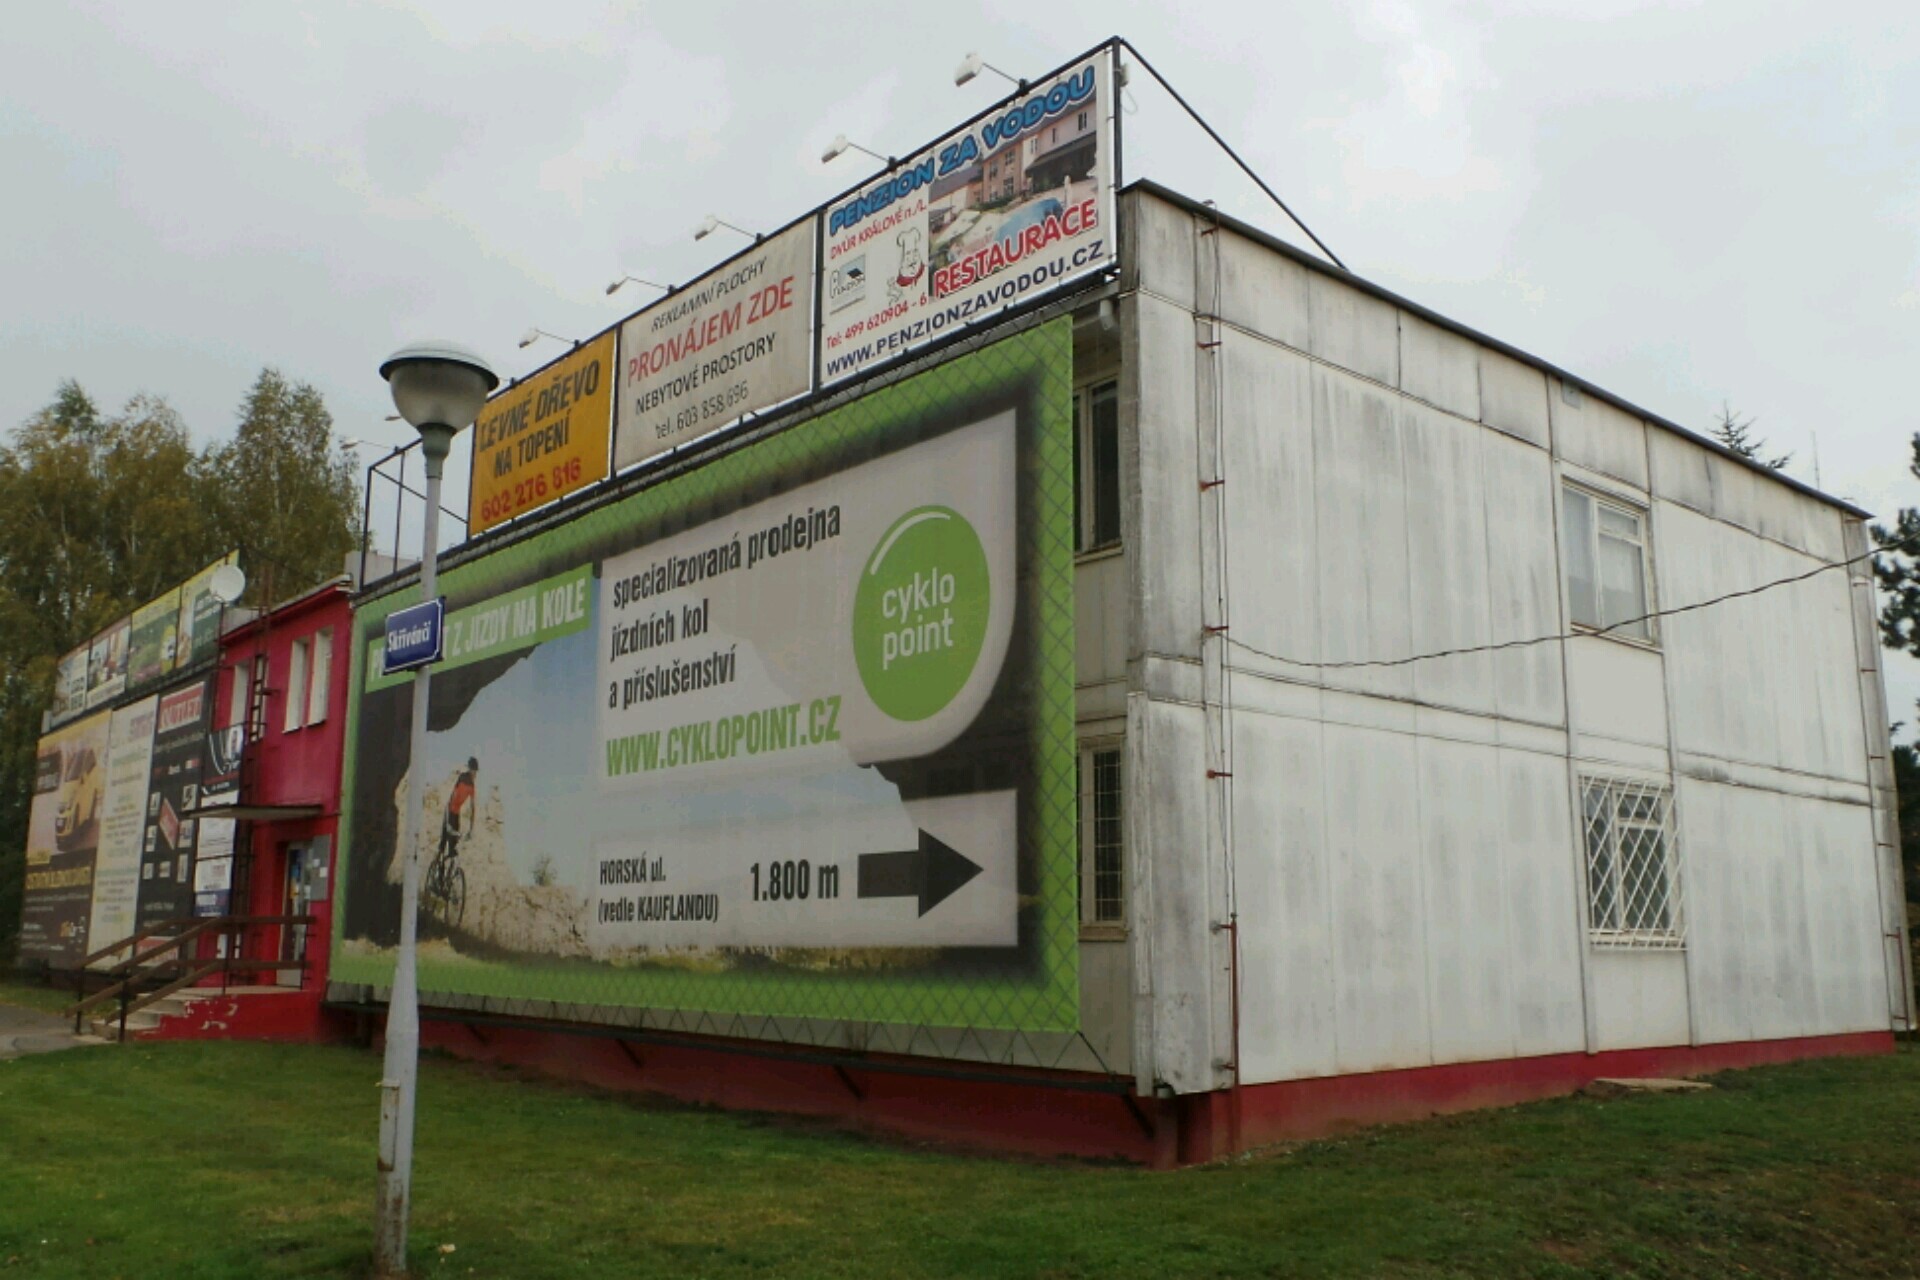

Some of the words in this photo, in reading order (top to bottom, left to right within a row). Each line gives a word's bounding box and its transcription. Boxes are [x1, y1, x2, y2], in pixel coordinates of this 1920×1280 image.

[829, 157, 935, 237] PENZION
[938, 134, 979, 176] ZA
[982, 65, 1095, 149] VODOU
[934, 199, 1098, 298] RESTAURACE
[651, 281, 717, 332] REKLAMNÍ
[716, 256, 767, 298] PLOCHY
[827, 240, 1104, 376] WWW.PENZIONZAVODOU.CZ
[845, 322, 864, 338] 499
[919, 291, 928, 307] 6
[627, 302, 742, 388] PRONÁJEM
[746, 276, 795, 325] ZDE
[480, 389, 533, 452] LEVNÉ
[535, 359, 599, 423] DŘEVO
[635, 363, 699, 416] NEBYTOVÉ
[702, 332, 776, 384] PROSTORY
[494, 446, 512, 479] NA
[517, 408, 571, 468] TOPENÍ
[655, 417, 674, 439] tel.
[677, 406, 698, 430] 603
[701, 394, 725, 420] 858
[481, 489, 513, 522] 602
[515, 473, 548, 508] 276
[552, 456, 582, 490] 816
[613, 531, 741, 608] specializovaná
[747, 504, 841, 569] prodejna
[452, 620, 464, 656] Z
[513, 596, 537, 639] NA
[542, 577, 586, 630] KOLE
[610, 610, 675, 662] jízdních
[681, 598, 708, 639] kol
[881, 567, 955, 624] cyklo
[882, 608, 954, 670] point
[608, 681, 618, 709] a
[623, 643, 737, 710] příslušenství
[606, 695, 842, 777] WWW.CYKLOPOINT.CZ
[600, 850, 647, 885] HORSKÁ
[651, 856, 667, 882] ul.
[749, 858, 810, 901] 1.800
[817, 862, 839, 899] m
[598, 898, 635, 925] (vedle
[638, 893, 719, 924] KAUFLANDU)
